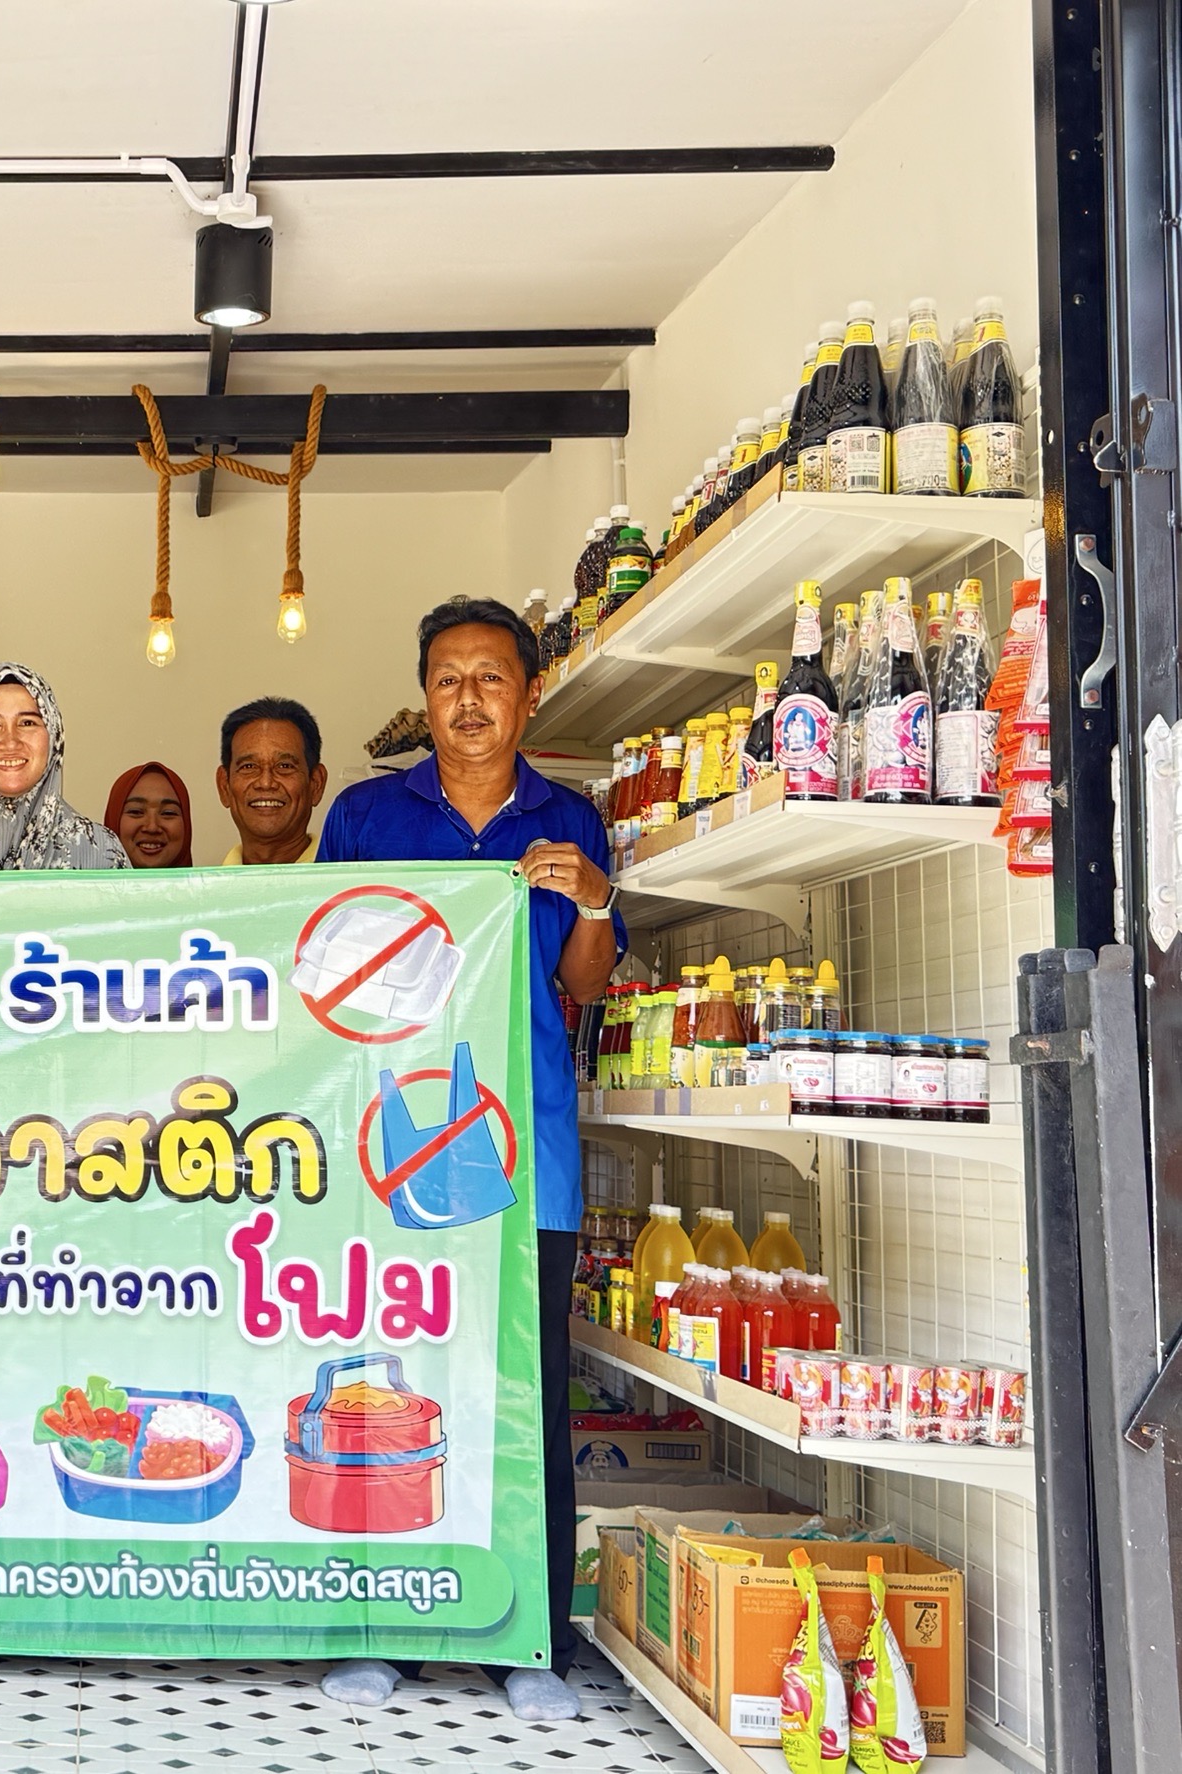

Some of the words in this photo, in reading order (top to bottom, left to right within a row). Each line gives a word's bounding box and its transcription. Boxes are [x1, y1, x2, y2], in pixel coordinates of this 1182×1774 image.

[8, 937, 270, 1025] ร้านค้า
[230, 1210, 456, 1339] โฟม
